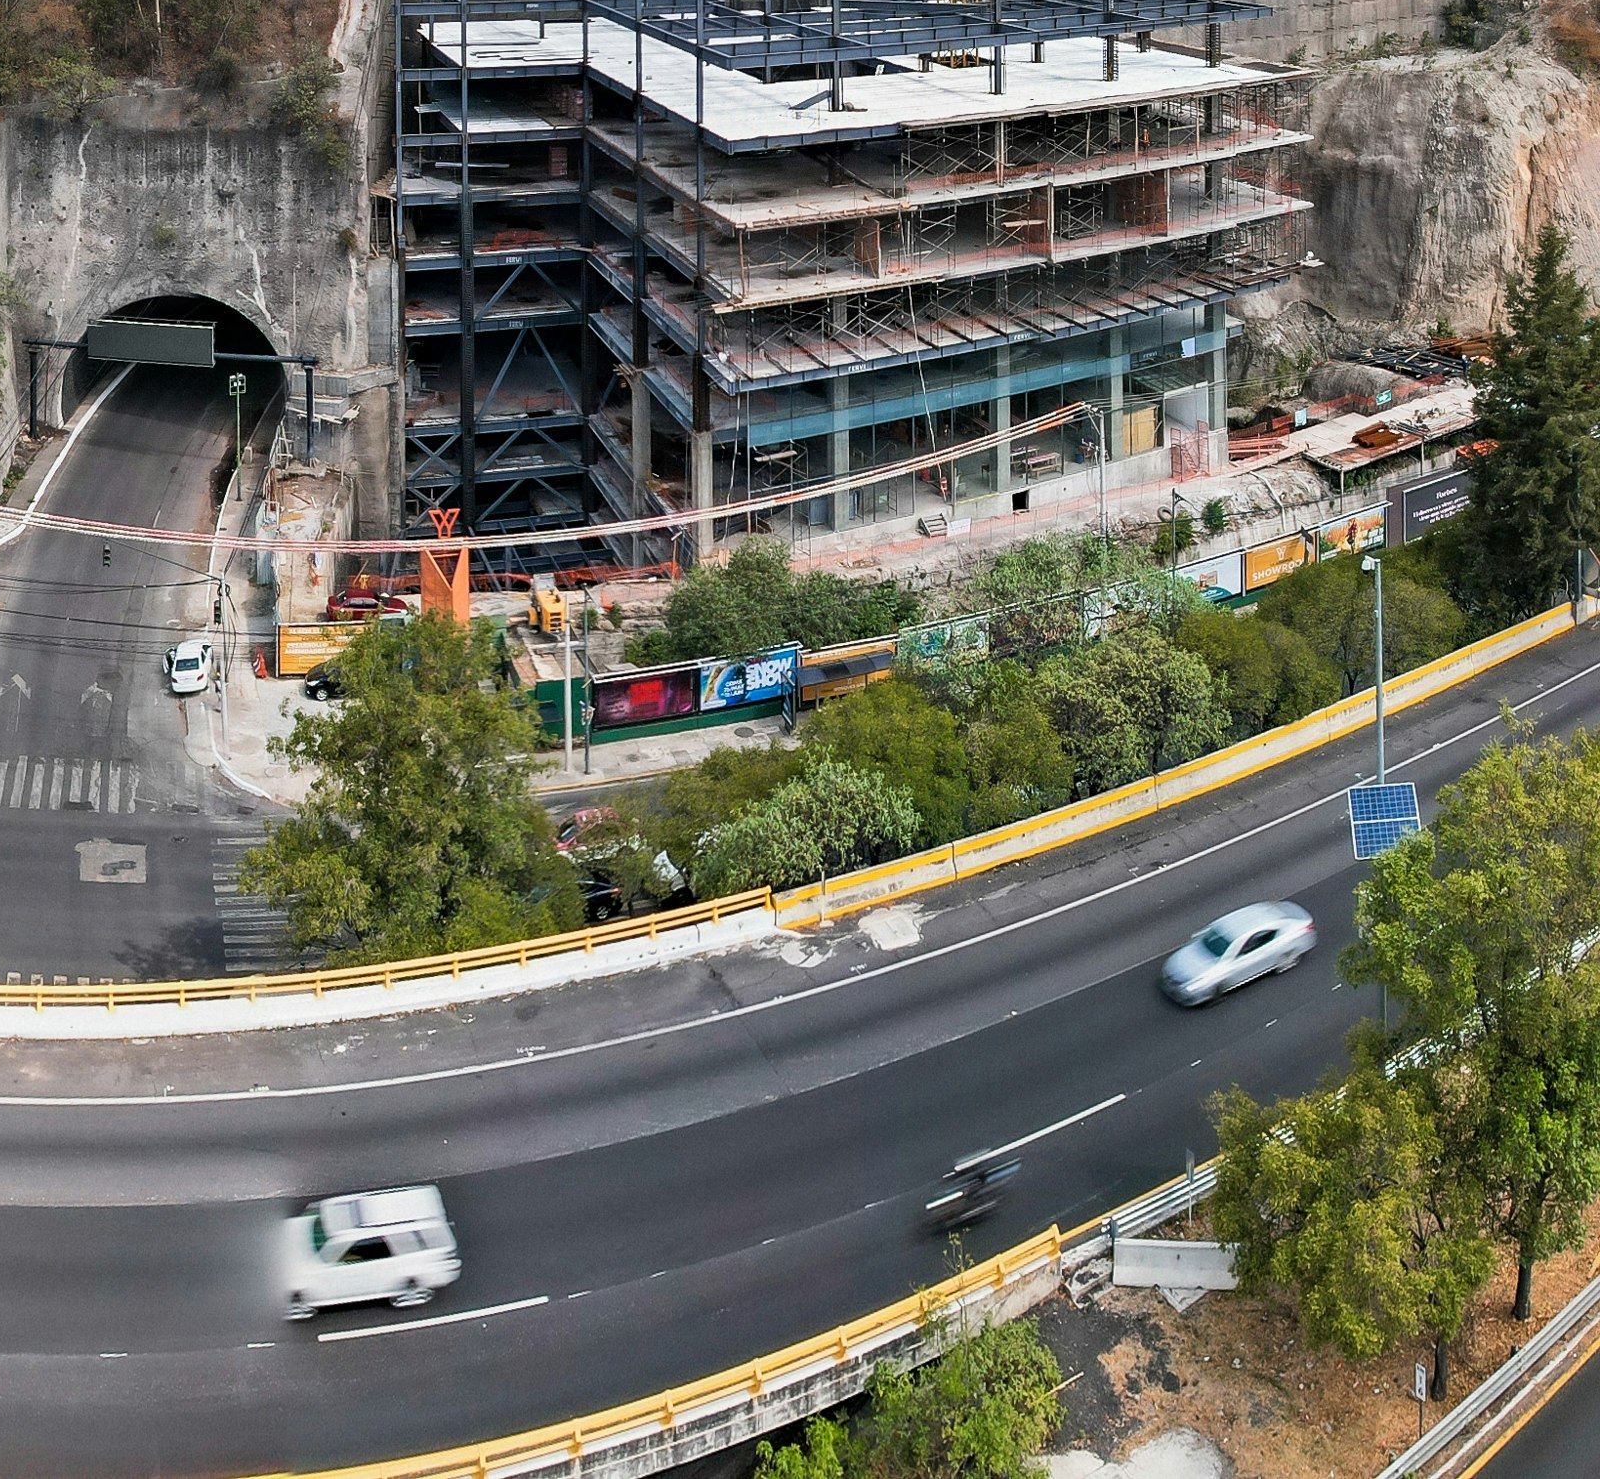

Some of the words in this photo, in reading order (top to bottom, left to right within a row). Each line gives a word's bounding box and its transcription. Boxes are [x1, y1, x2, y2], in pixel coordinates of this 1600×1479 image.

[1435, 487, 1458, 499] Forbes
[1252, 559, 1303, 582] SHOWROO
[746, 657, 793, 676] SNOW
